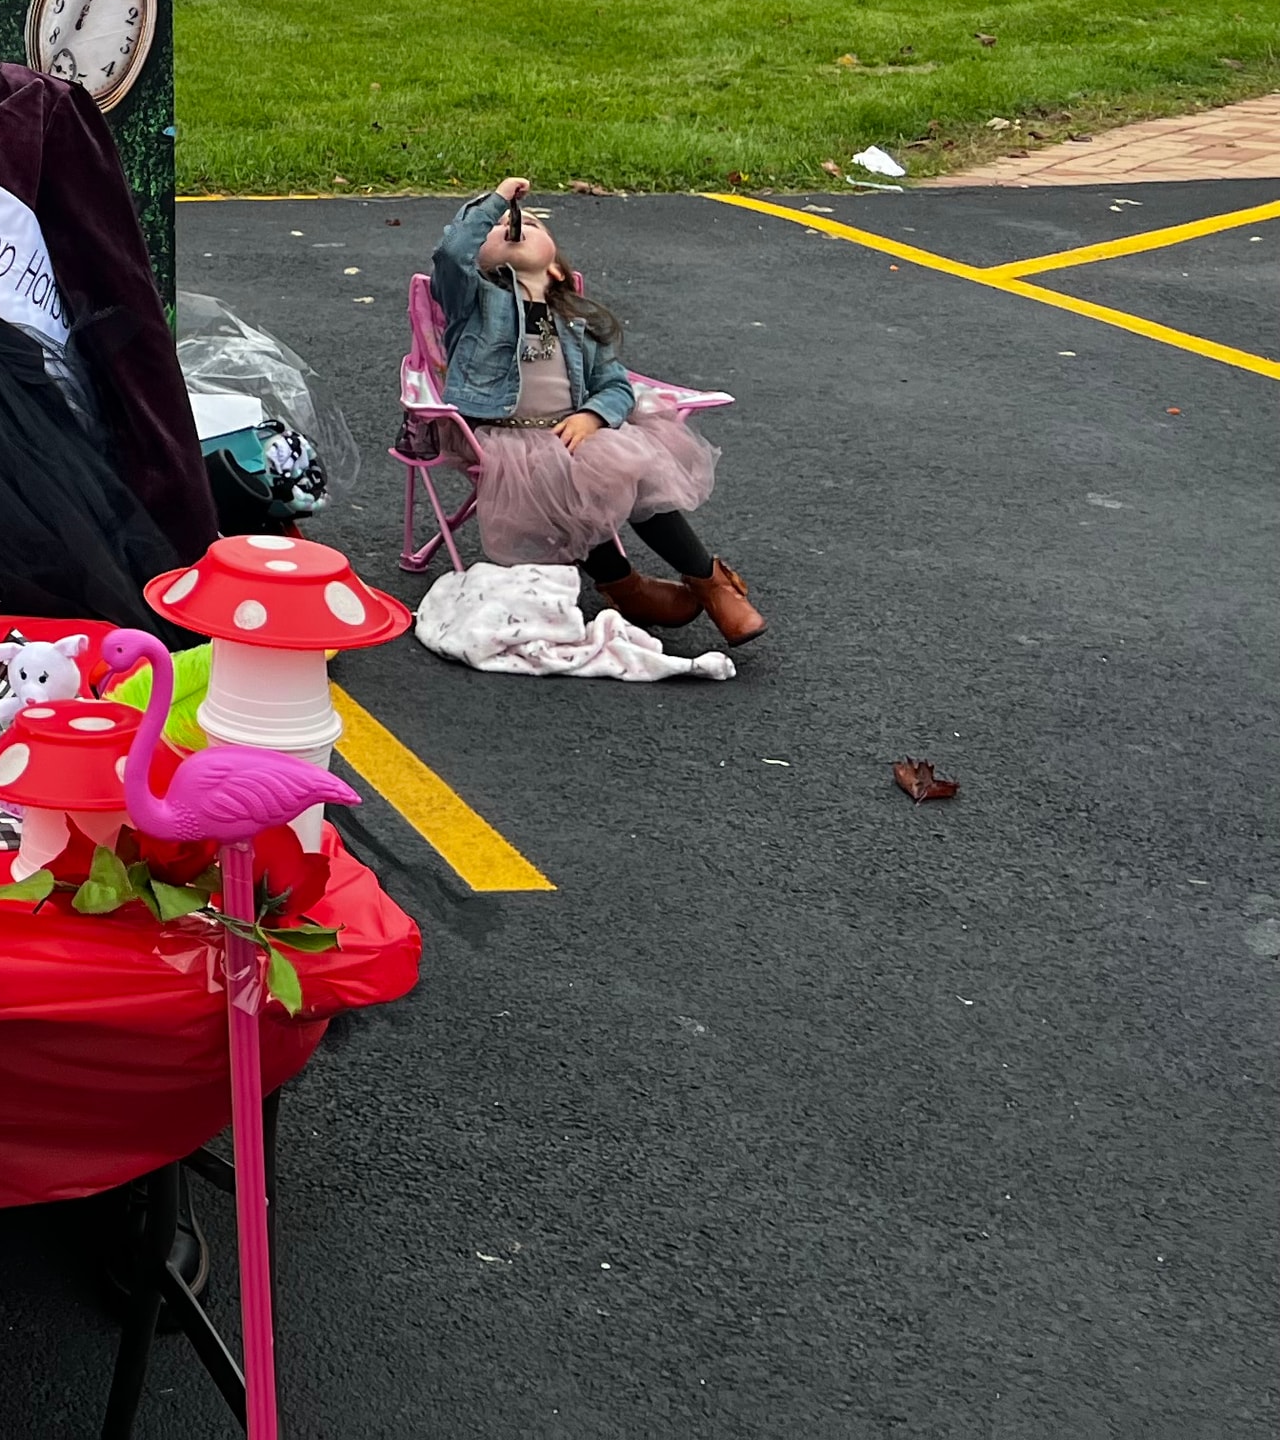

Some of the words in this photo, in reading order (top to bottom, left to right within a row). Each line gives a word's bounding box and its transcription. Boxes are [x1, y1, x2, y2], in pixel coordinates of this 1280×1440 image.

[125, 7, 139, 26] 2
[49, 26, 60, 45] 8
[120, 37, 134, 55] 3
[101, 60, 117, 78] 4
